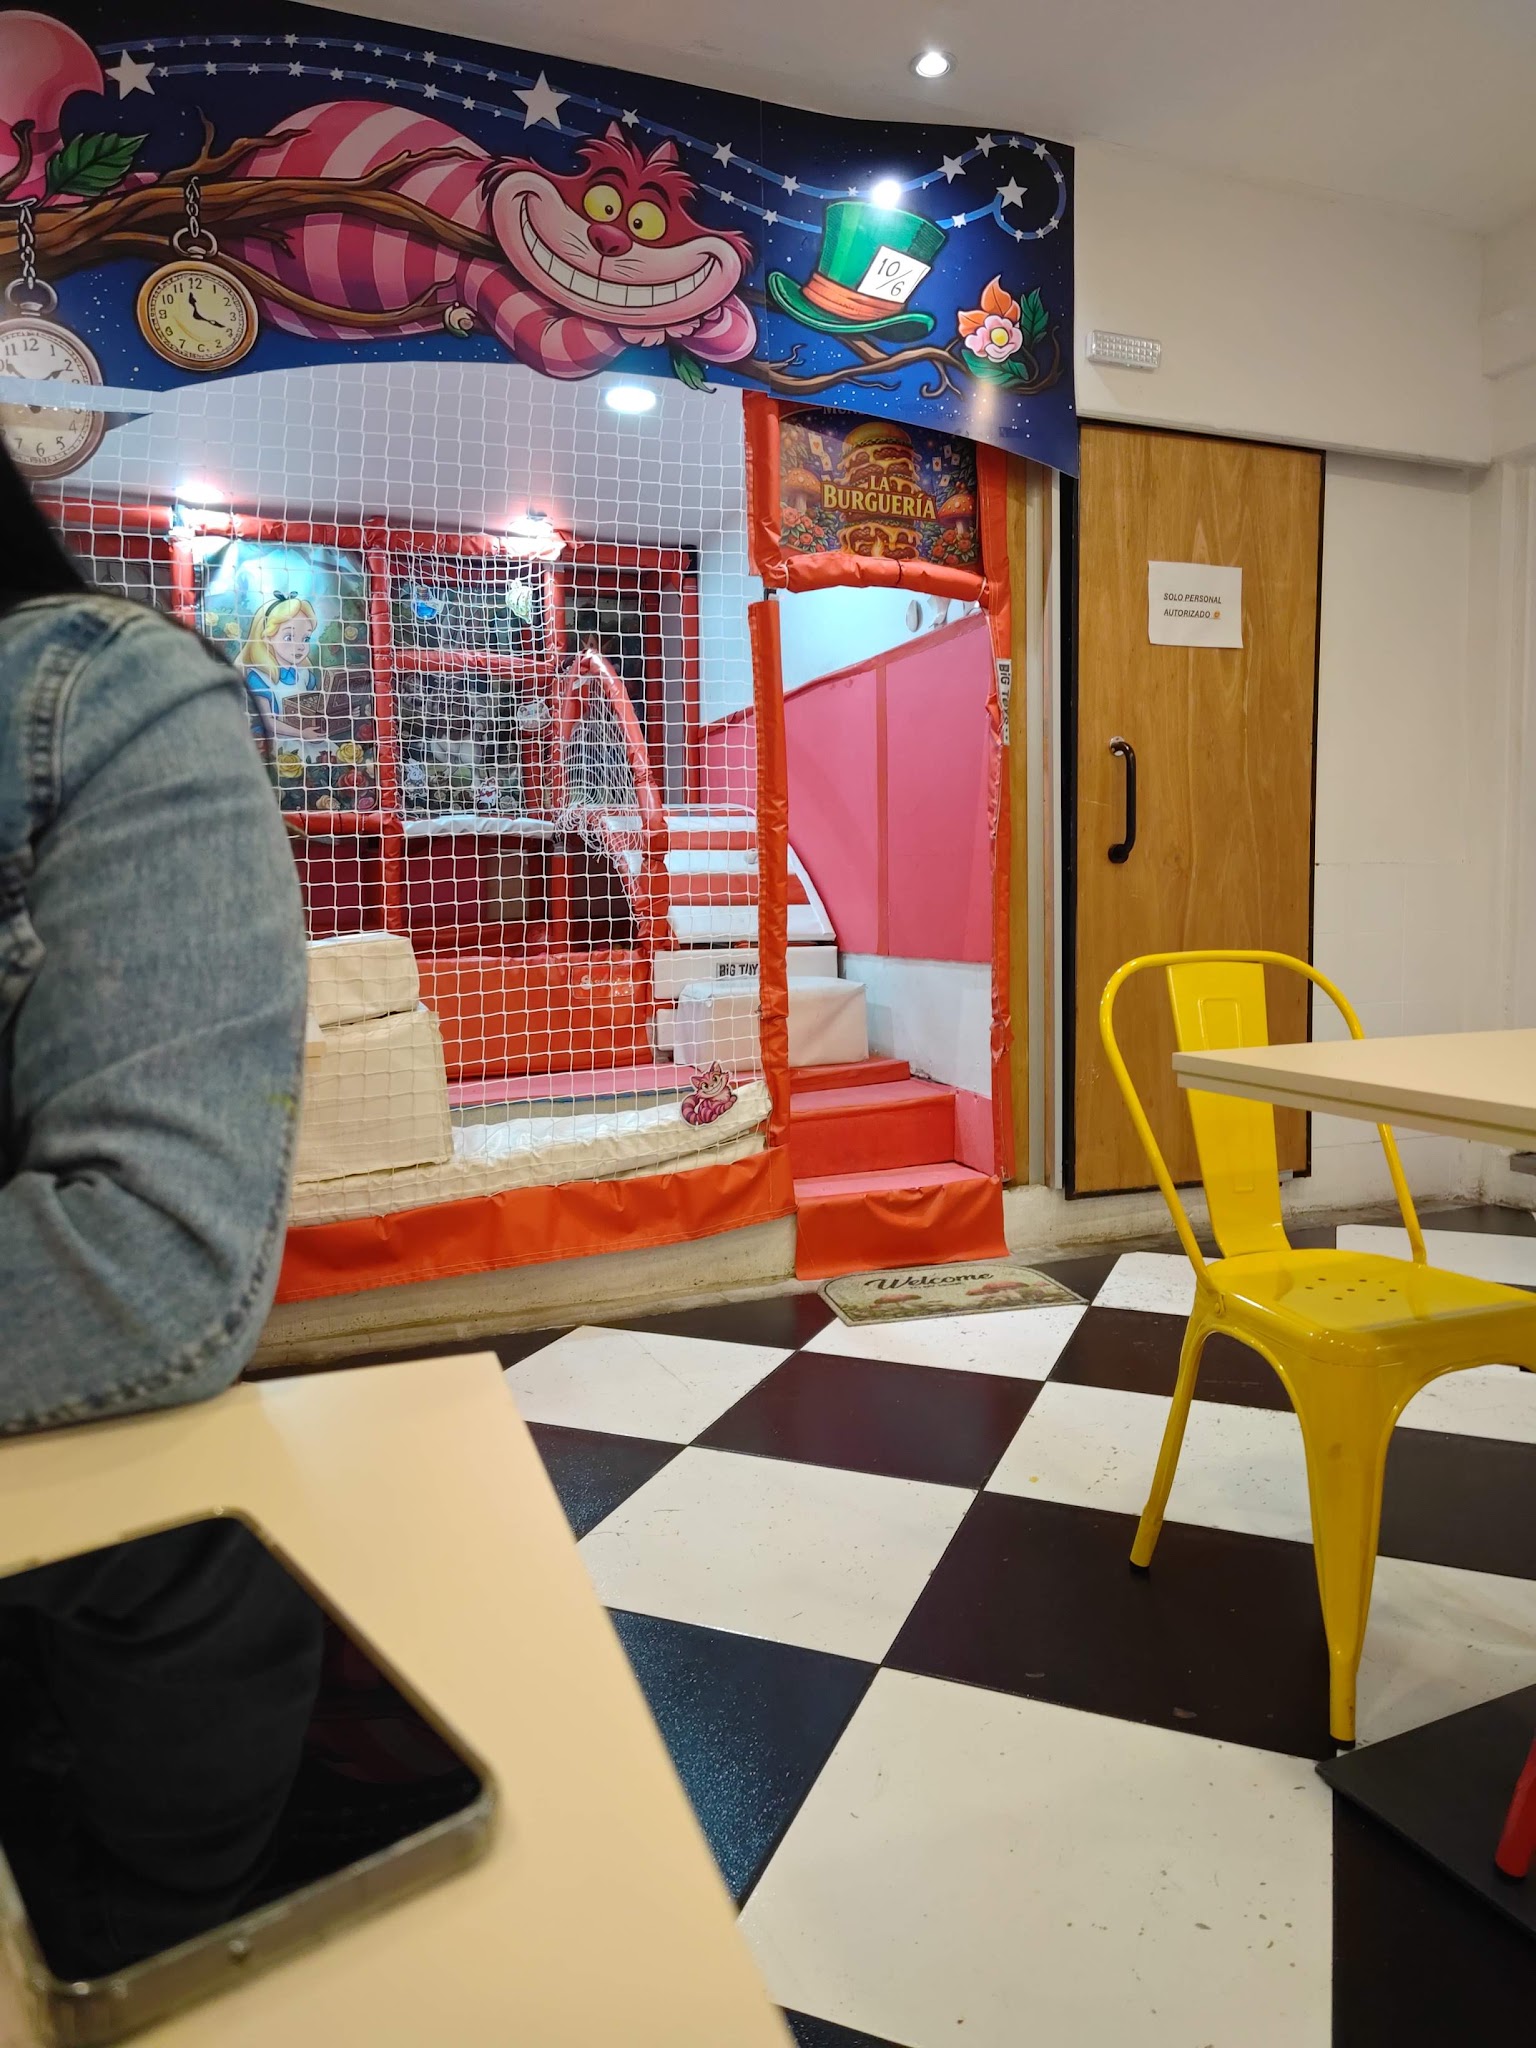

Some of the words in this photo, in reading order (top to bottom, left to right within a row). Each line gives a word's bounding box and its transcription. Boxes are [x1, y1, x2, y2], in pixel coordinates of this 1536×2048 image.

[173, 282, 183, 293] 11
[188, 277, 202, 289] 12
[213, 284, 217, 294] 1
[162, 294, 174, 304] 10
[223, 297, 231, 306] 2
[229, 311, 237, 321] 3
[4, 343, 19, 356] 11
[23, 338, 40, 352] 12
[178, 338, 186, 349] 7
[50, 344, 56, 357] 1
[64, 359, 73, 371] 2
[68, 420, 78, 434] 4
[14, 437, 23, 449] 7
[56, 436, 65, 450] 5
[36, 442, 45, 457] 6
[870, 475, 890, 492] LA
[823, 484, 937, 520] BURGUERÍA
[1163, 592, 1183, 602] SOLO
[1184, 594, 1222, 604] PERSONAL
[1163, 608, 1211, 619] AUTORIZADO
[864, 1273, 995, 1290] Welcome
